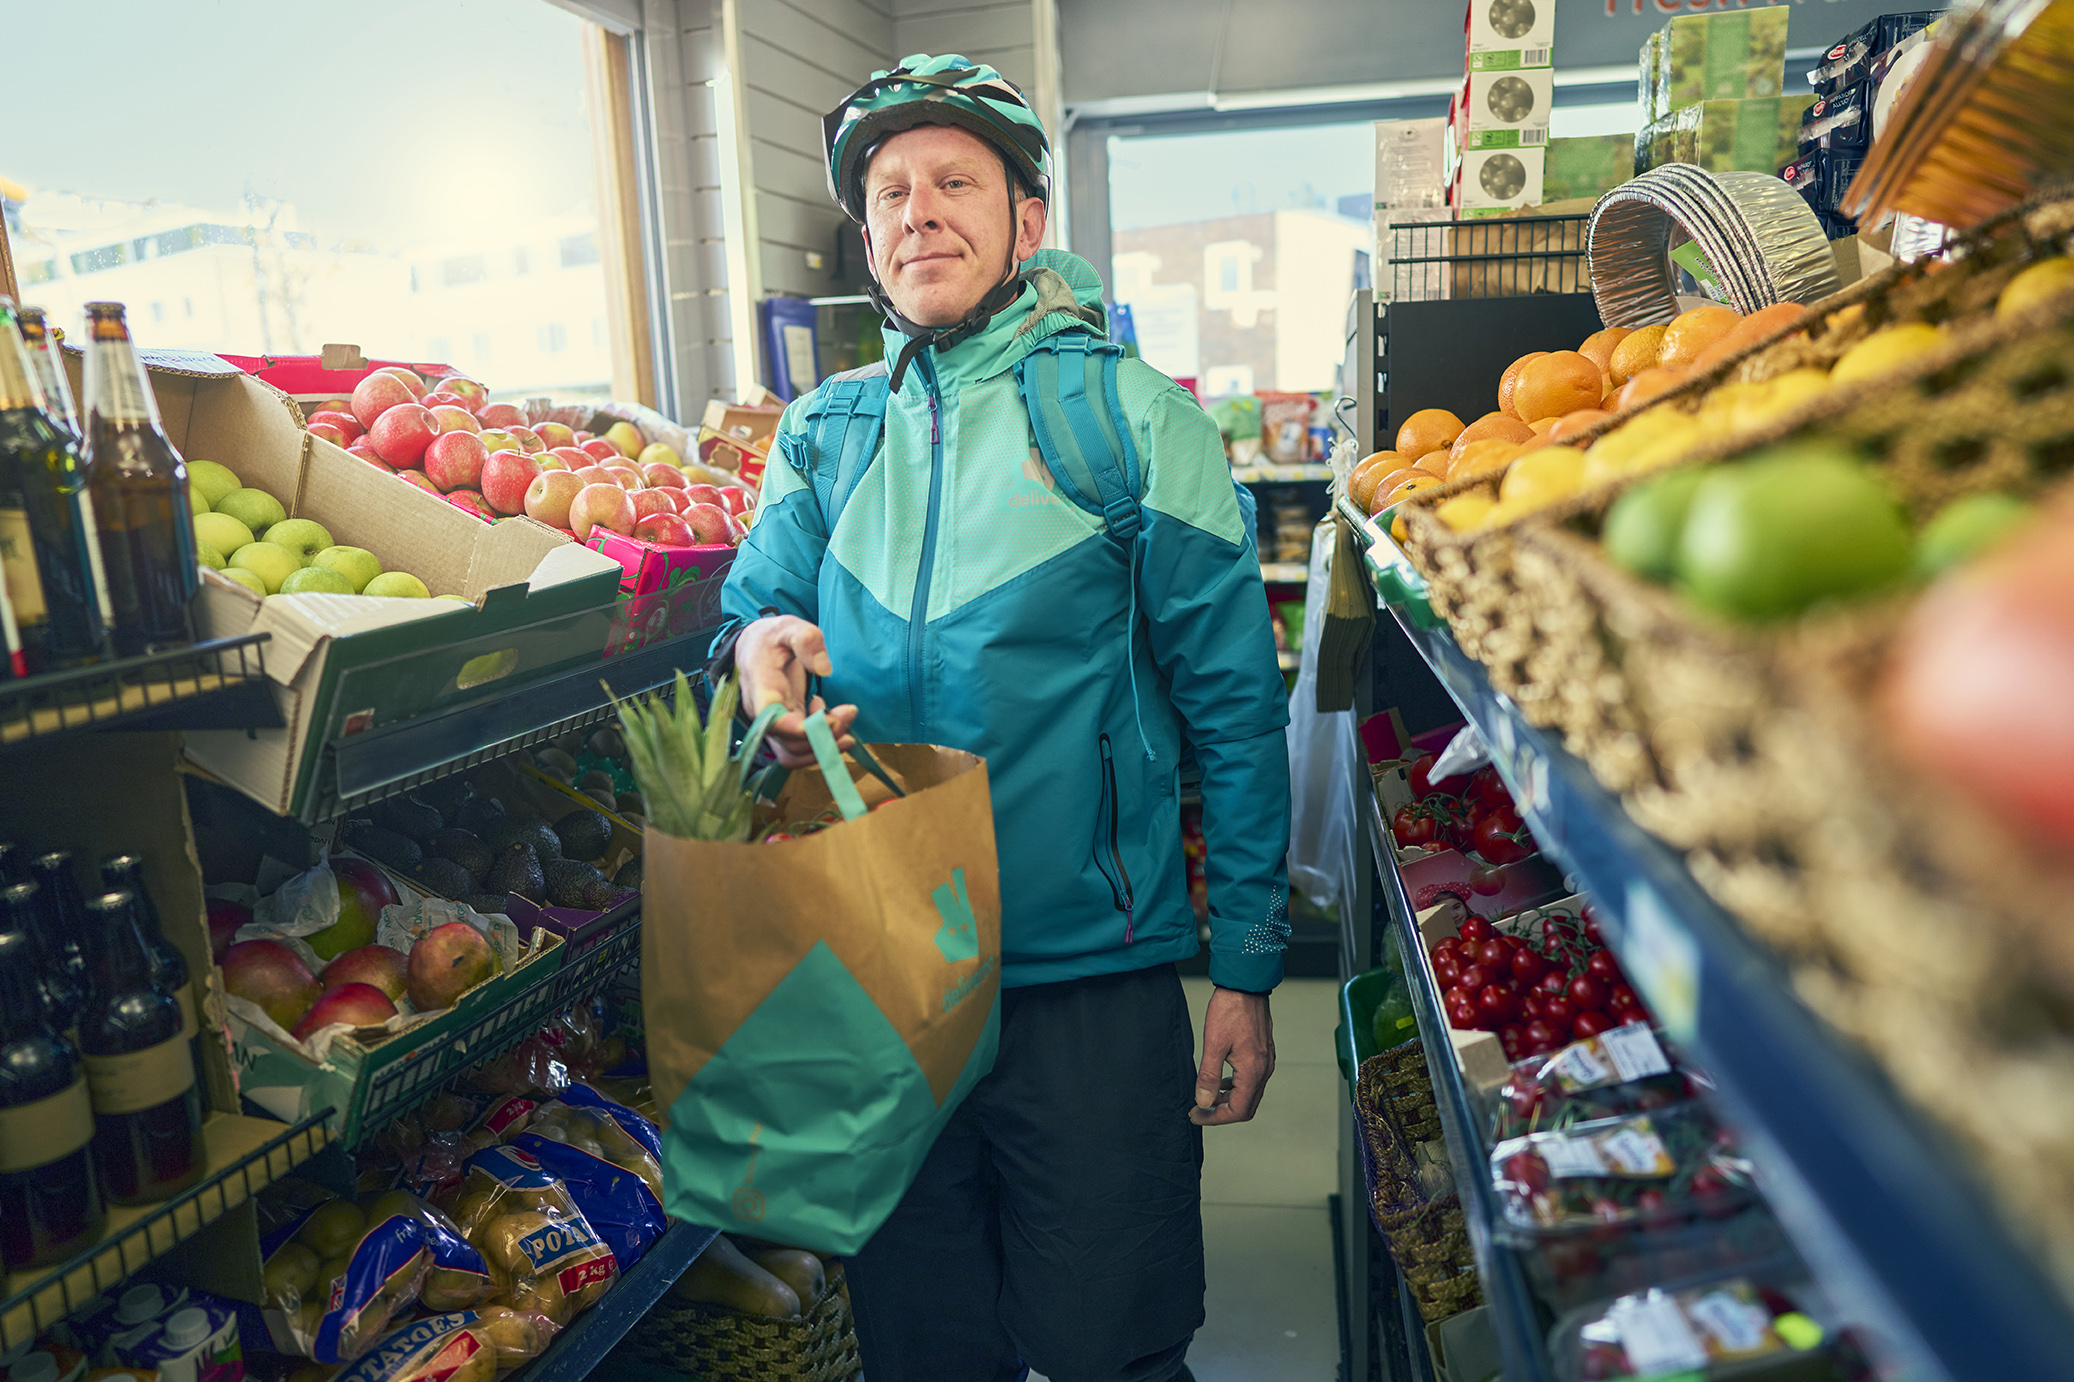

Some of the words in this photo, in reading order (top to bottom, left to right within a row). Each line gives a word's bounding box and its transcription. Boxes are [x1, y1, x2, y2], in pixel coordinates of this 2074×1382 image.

[530, 1221, 596, 1260] POTA
[578, 1270, 588, 1281] 2
[590, 1264, 606, 1277] kg
